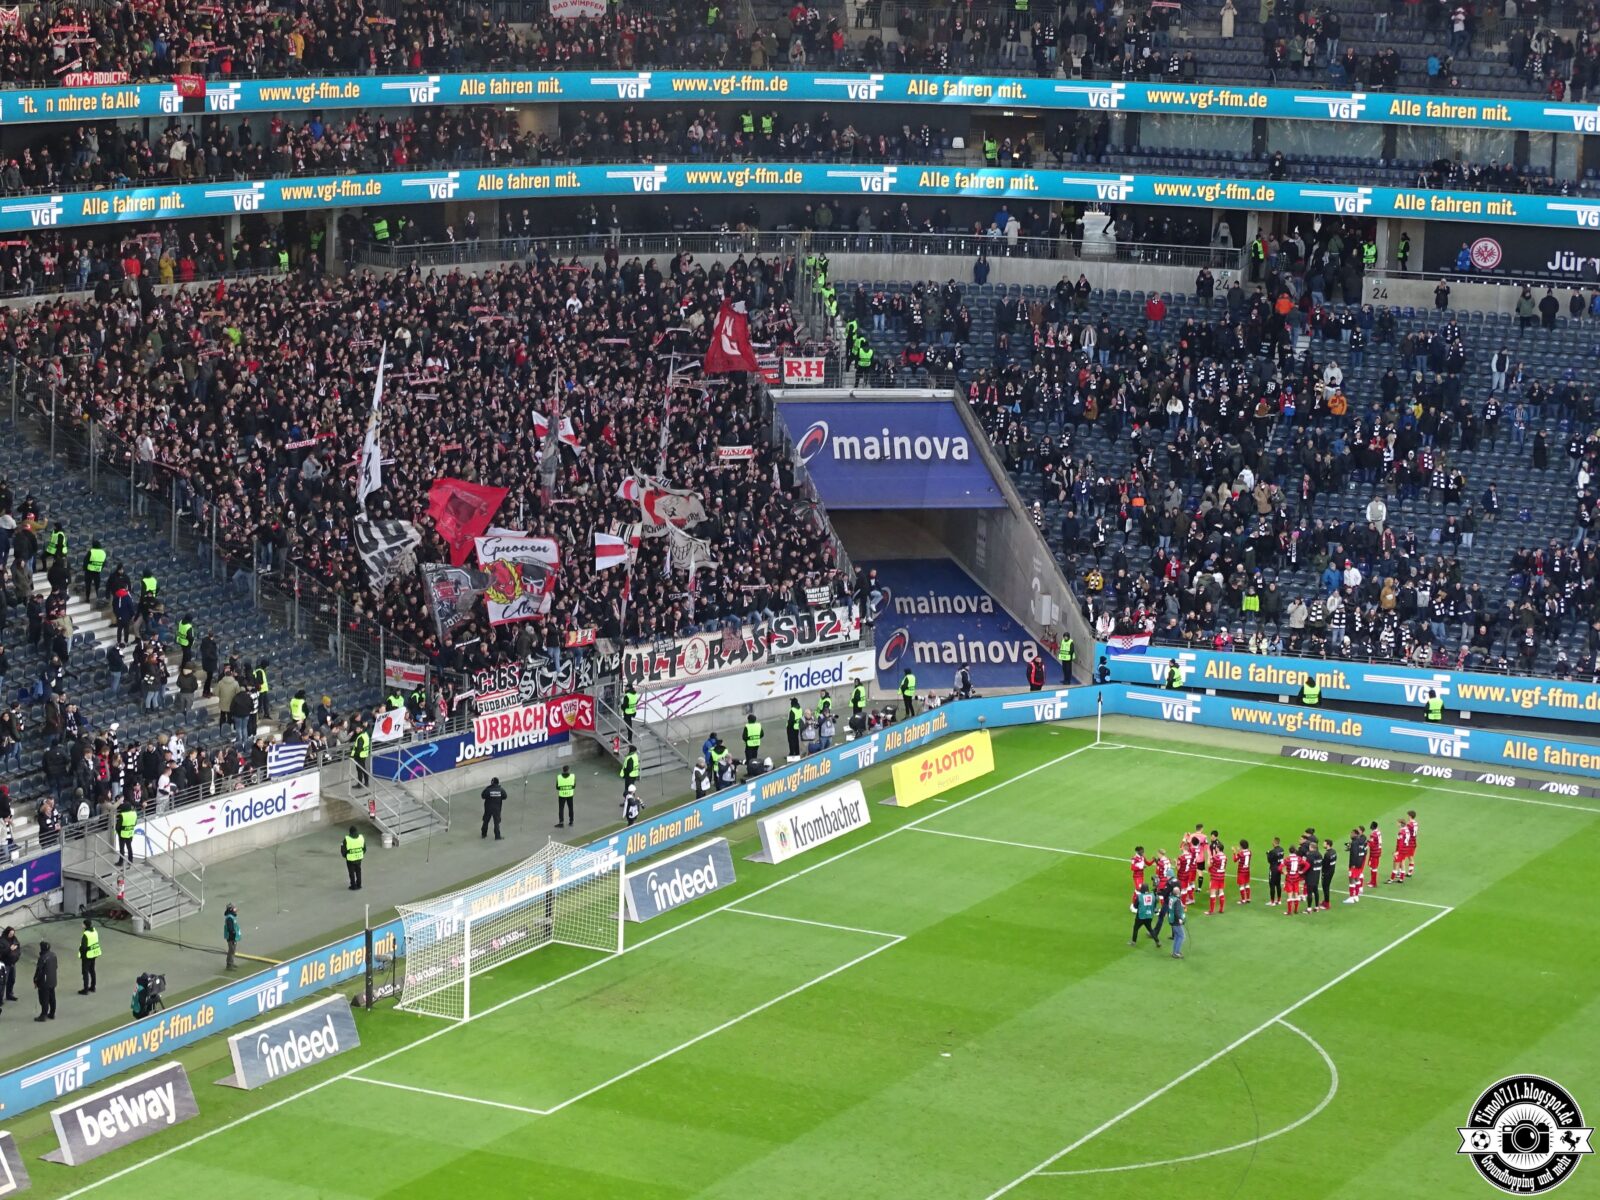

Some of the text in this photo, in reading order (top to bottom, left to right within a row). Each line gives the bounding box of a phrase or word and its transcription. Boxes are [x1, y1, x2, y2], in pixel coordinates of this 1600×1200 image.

[210, 82, 241, 110] VGF
[259, 82, 360, 102] www.vgf-ffm.de
[409, 76, 440, 102] VGF
[460, 77, 563, 95] Alle fahren mit.
[617, 72, 651, 98] VGF
[672, 75, 788, 94] www.vgf-ffm.de
[847, 74, 884, 100] VGF
[907, 79, 1026, 99] Alle fahren mit.
[1088, 82, 1125, 107] VGF
[1147, 90, 1267, 108] www.vgf-ffm.de
[1328, 93, 1367, 119] VGF
[1390, 99, 1512, 121] Alle fahren mit.
[281, 179, 382, 201] www.vgf-ffm.de
[429, 172, 460, 199] VGF
[478, 171, 580, 191] Alle fahren mit.
[633, 165, 667, 192] VGF
[686, 168, 803, 187] www.vgf-ffm.de
[860, 166, 897, 191] VGF
[919, 171, 1039, 191] Alle fahren mit.
[1096, 175, 1134, 200] VGF
[82, 191, 184, 216] Alle fahren mit.
[234, 182, 264, 210] VGF
[1154, 182, 1275, 201] www.vgf-ffm.de
[1334, 187, 1372, 213] VGF
[1394, 194, 1516, 215] Alle fahren mit.
[31, 196, 63, 225] VGF
[1372, 288, 1388, 300] 24
[785, 361, 824, 377] RH
[832, 428, 969, 460] mainova
[895, 590, 993, 614] mainova
[914, 635, 1038, 663] mainova
[784, 661, 843, 691] indeed
[1205, 660, 1351, 690] Alle fahren mit.
[1034, 690, 1068, 720] VGF
[1162, 694, 1201, 722] VGF
[476, 705, 544, 743] URBACH
[885, 712, 948, 752] Alle fahren mit.
[1231, 706, 1362, 737] www.vgf-ffm.de
[858, 733, 879, 768] VGF
[1300, 749, 1328, 762] DWS
[1428, 728, 1470, 757] VGF
[1503, 740, 1537, 761] Alle
[935, 745, 974, 775] LOTTO
[1361, 757, 1390, 770] DWS
[1423, 765, 1452, 778] DWS
[761, 758, 831, 800] www.vgf-ffm.de
[1486, 773, 1515, 787] DWS
[1549, 782, 1579, 796] DWS
[225, 789, 286, 828] indeed
[733, 782, 756, 820] VGF
[627, 811, 703, 855] Alle fahren mit.
[789, 797, 862, 849] Krombacher
[651, 855, 718, 911] indeed
[300, 961, 325, 987] Alle
[257, 966, 289, 1012] VGF
[101, 1004, 214, 1066] www.vgf-ffm.de
[262, 1015, 338, 1077] indeed
[54, 1045, 90, 1096] VGF
[76, 1081, 177, 1147] betway
